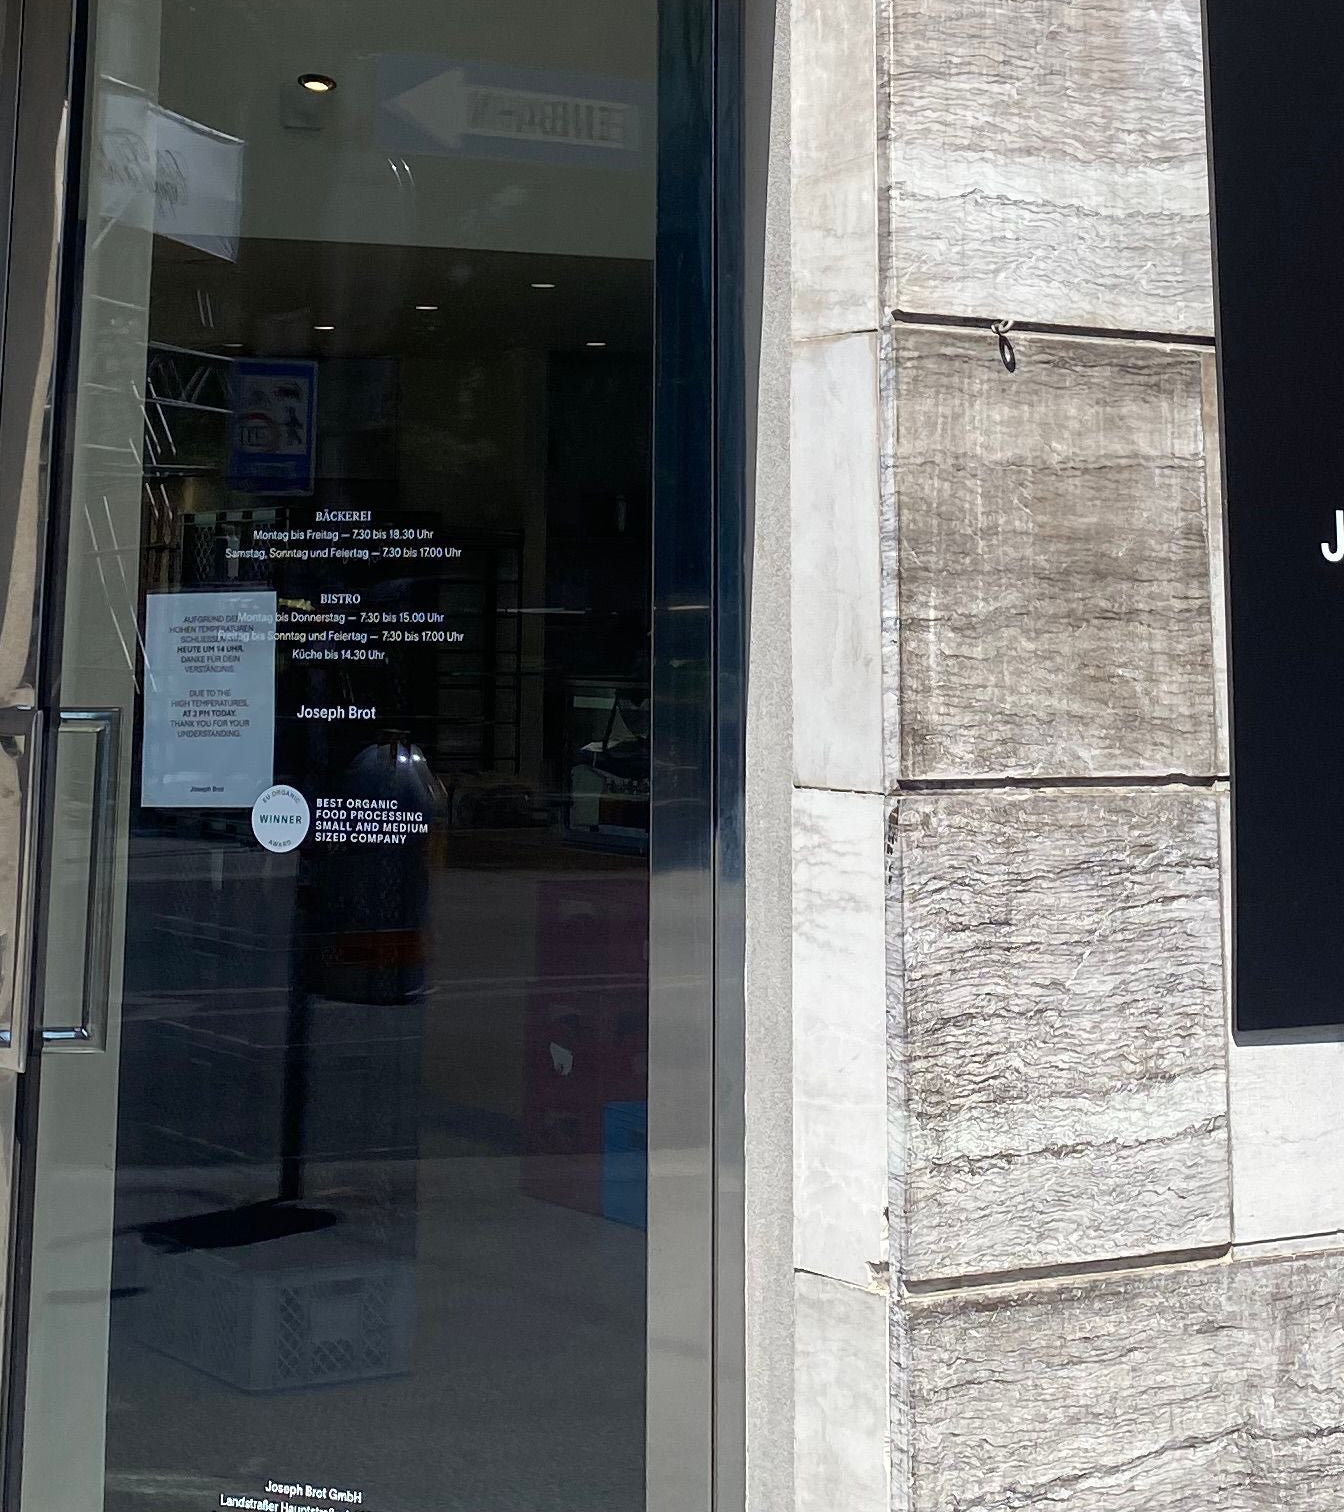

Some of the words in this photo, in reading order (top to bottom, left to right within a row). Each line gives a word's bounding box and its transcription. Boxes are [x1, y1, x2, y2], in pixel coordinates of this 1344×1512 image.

[315, 509, 372, 522] BÄCKEREI
[253, 529, 289, 542] Montag
[290, 529, 305, 540] bis
[306, 529, 339, 542] Freitag
[373, 529, 387, 540] bis
[417, 529, 435, 540] Uhr
[269, 548, 308, 560] Sonntag
[310, 548, 328, 558] und
[330, 547, 370, 560] Feiertag
[403, 547, 418, 558] bis
[445, 547, 462, 558] Uhr
[320, 593, 361, 604] BISTRO
[237, 612, 274, 624] Montag
[275, 612, 289, 623] bis
[291, 612, 346, 624] Donnerstag
[382, 612, 397, 623] bis
[399, 612, 425, 623] 15.00
[427, 612, 445, 623] Uhr
[269, 631, 307, 643] Sonntag
[309, 631, 326, 641] und
[328, 631, 368, 643] Feiertag
[404, 631, 420, 642] bis
[447, 631, 465, 642] Uhr
[292, 649, 323, 660] Küche
[324, 649, 338, 660] bis
[341, 649, 366, 660] 14.30
[368, 649, 386, 660] Uhr
[296, 705, 345, 722] Joseph
[348, 705, 376, 719] Brot
[316, 798, 343, 808] BEST
[346, 798, 398, 809] ORGANIC
[259, 814, 302, 824] WINNER
[316, 810, 347, 819] FOOD
[350, 811, 423, 822] PROCESSING
[315, 821, 352, 831] SMALL
[356, 822, 379, 832] AND
[382, 822, 429, 833] MEDIUM
[268, 839, 292, 848] AWARD
[315, 832, 347, 842] SIZED
[350, 833, 407, 844] COMPANY
[265, 1480, 303, 1498] Joseph
[305, 1485, 327, 1499] Brot
[328, 1488, 362, 1503] GmbH
[220, 1493, 279, 1512] Landstraßer
